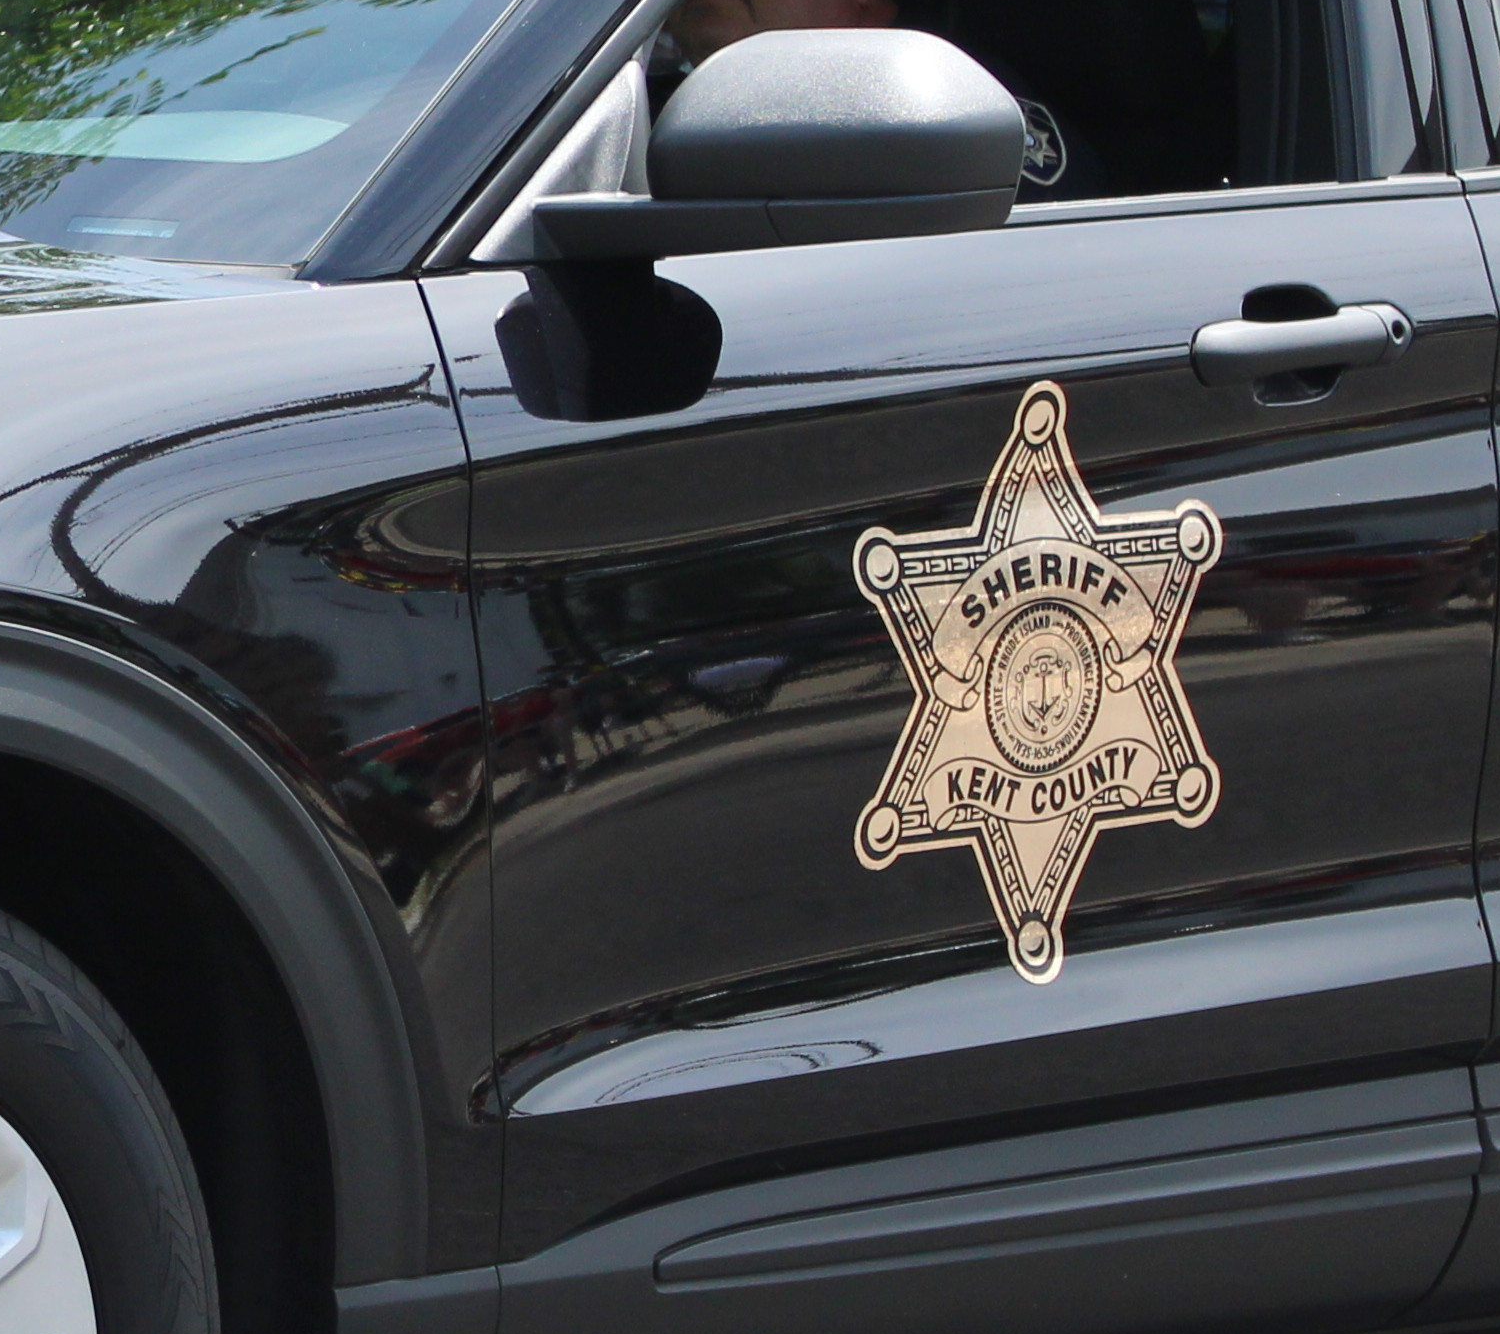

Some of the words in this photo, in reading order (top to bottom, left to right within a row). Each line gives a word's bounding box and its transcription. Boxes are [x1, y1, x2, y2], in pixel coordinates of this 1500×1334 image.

[961, 552, 1128, 629] SHERIFF
[998, 635, 1021, 672] RHODE
[1019, 615, 1050, 639] ISLAND
[1064, 622, 1094, 685] PROVIDENCE
[1056, 687, 1094, 755] PLANTATIONS
[947, 767, 1021, 813] KENT
[1031, 747, 1138, 814] COUNTY
